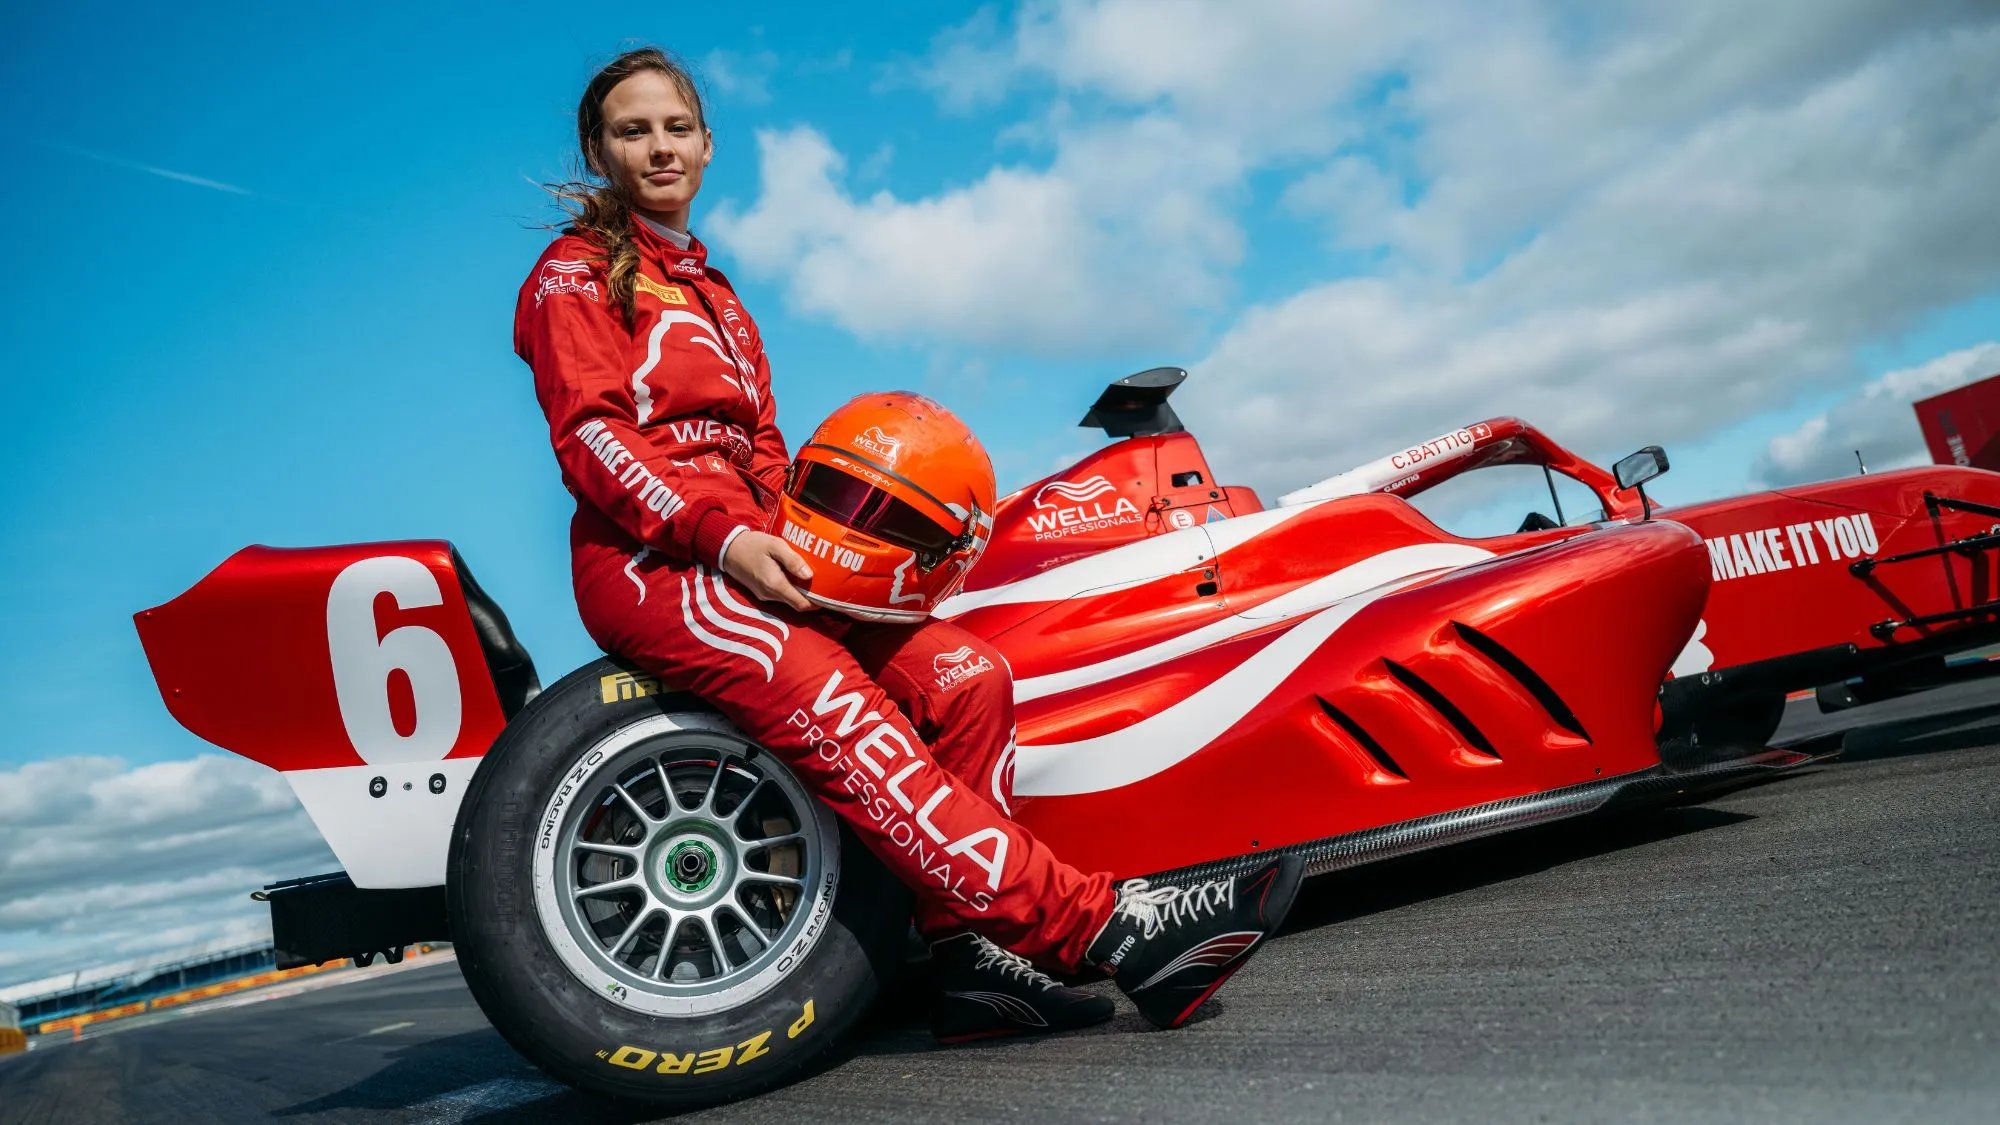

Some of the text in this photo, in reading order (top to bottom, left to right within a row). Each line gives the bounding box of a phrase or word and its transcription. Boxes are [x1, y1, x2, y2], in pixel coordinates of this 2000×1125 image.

[534, 275, 599, 302] WELLA
[576, 419, 686, 521] MAKE IT YOU
[848, 464, 894, 487] ACADEMY
[1027, 497, 1140, 533] WELLA
[1034, 513, 1144, 542] PROFESSIONALS
[781, 519, 866, 573] MAKE IT YOU
[1704, 513, 1880, 582] MAKE IT YOU
[326, 556, 462, 765] 6
[934, 655, 993, 687] WELLA
[811, 669, 1009, 892] WELLA
[541, 785, 573, 849] RACING
[786, 708, 994, 912] PROFESSIONALS
[806, 873, 834, 937] RACING
[1109, 935, 1136, 966] BÄTTIG
[787, 999, 815, 1039] P
[608, 1030, 772, 1075] ZERO
